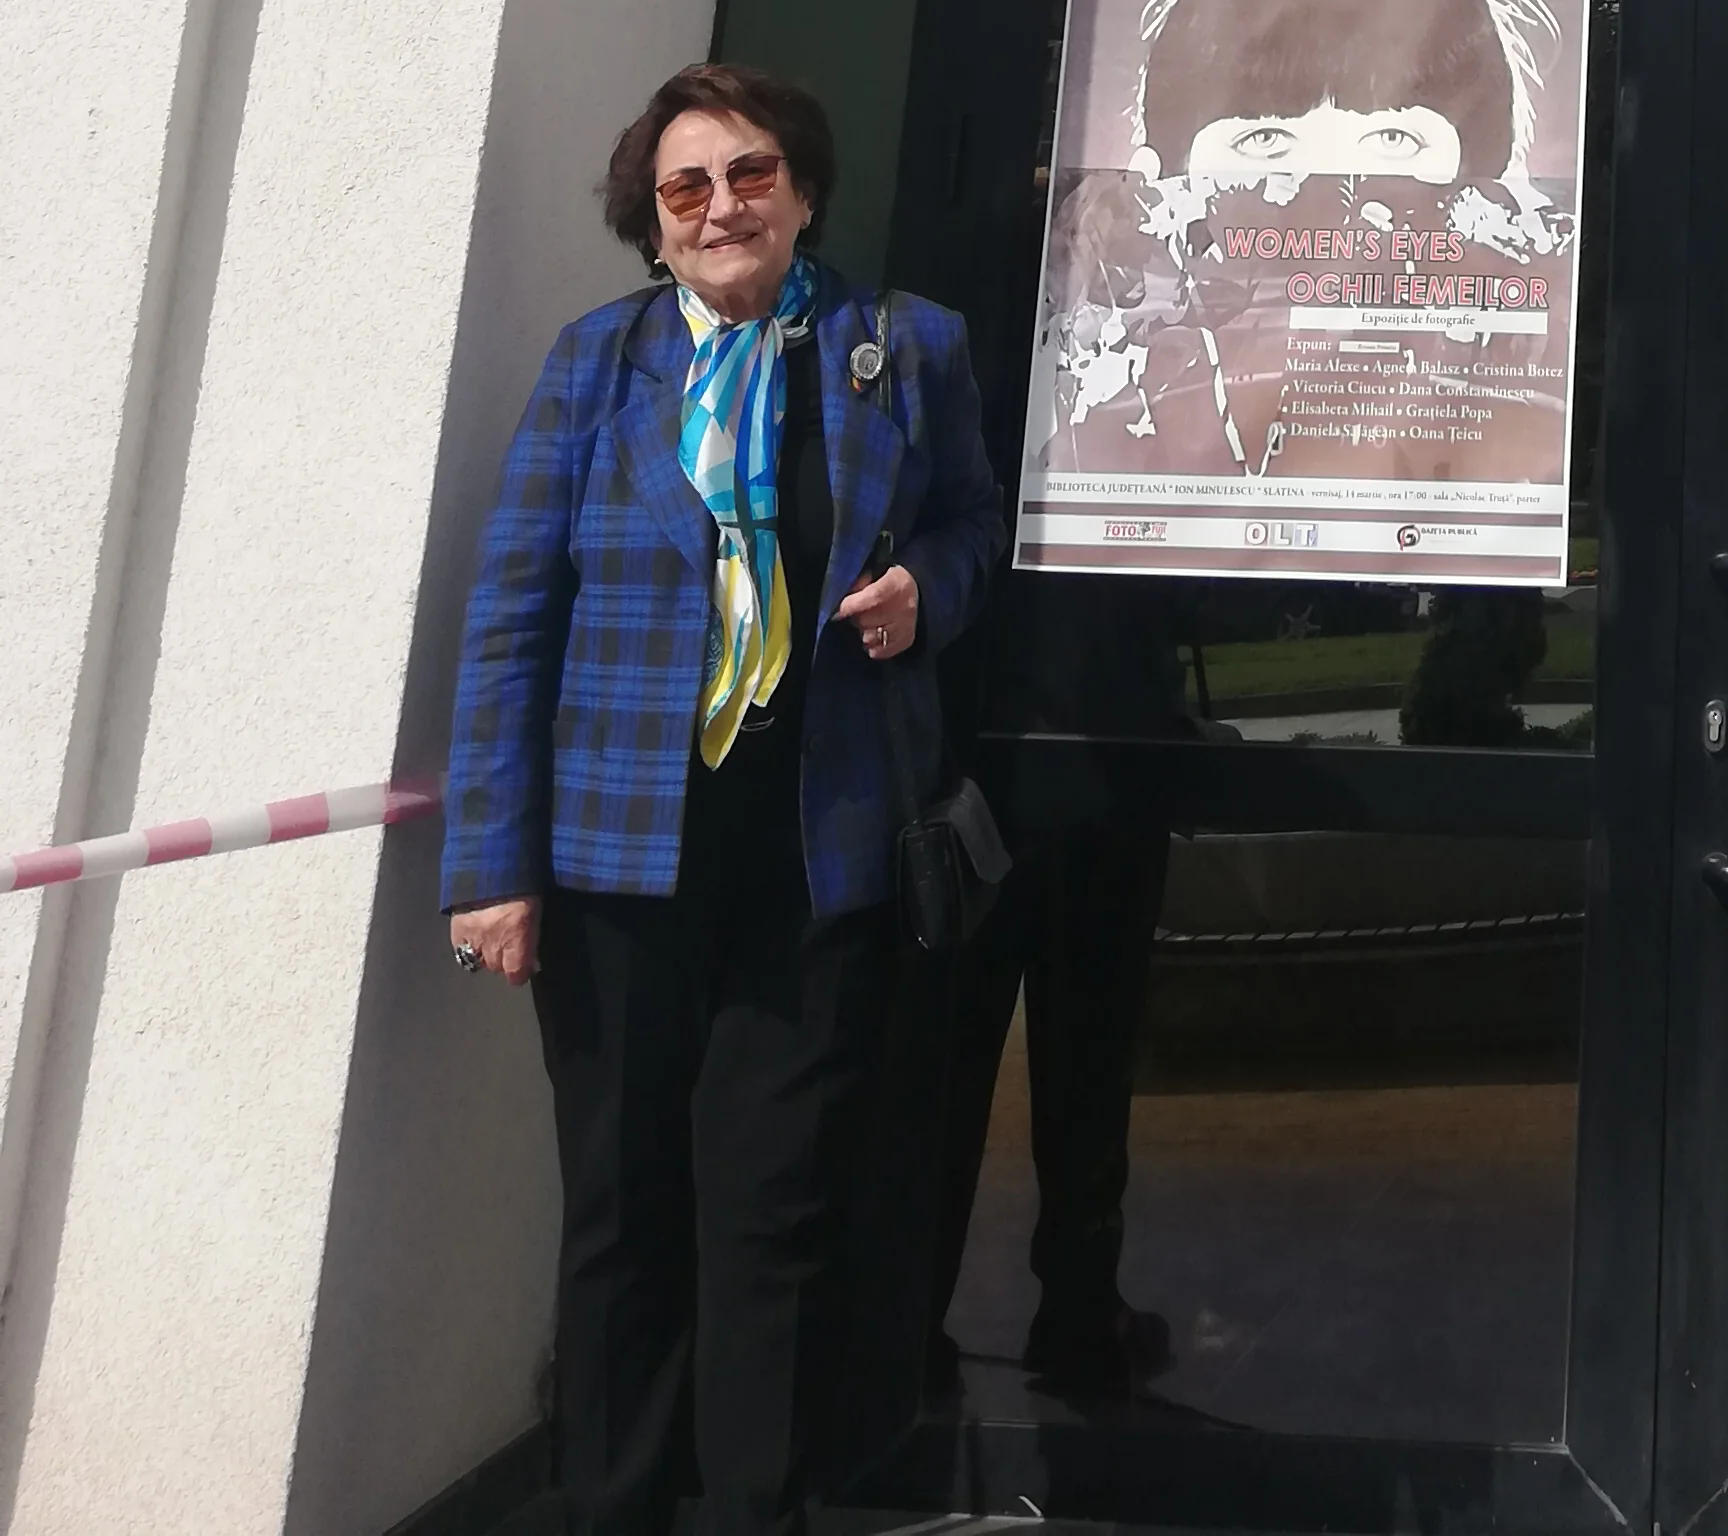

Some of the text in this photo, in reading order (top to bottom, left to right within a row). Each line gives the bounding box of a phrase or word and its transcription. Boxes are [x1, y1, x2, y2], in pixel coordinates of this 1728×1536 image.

[1224, 227, 1466, 263] WOMEN'S EYES
[1287, 273, 1548, 309] OCHII FEMEILOR
[1361, 312, 1476, 330] Expoziție de fotografie
[1286, 337, 1331, 354] Expun:
[1284, 357, 1564, 378] Maria Alexe Agne Balasz Cristina Botez
[1292, 379, 1345, 394] Victoria
[1347, 380, 1386, 395] Ciucu
[1399, 381, 1432, 396] Dana
[1291, 400, 1493, 423] Elisabeta Mihail Grațiela Popa
[1290, 422, 1341, 437] Daniela
[1409, 425, 1445, 440] Oana
[1046, 482, 1106, 493] BIBLIOTECA
[1264, 487, 1305, 497] SLATINA
[1105, 524, 1167, 537] FOTO FUJI
